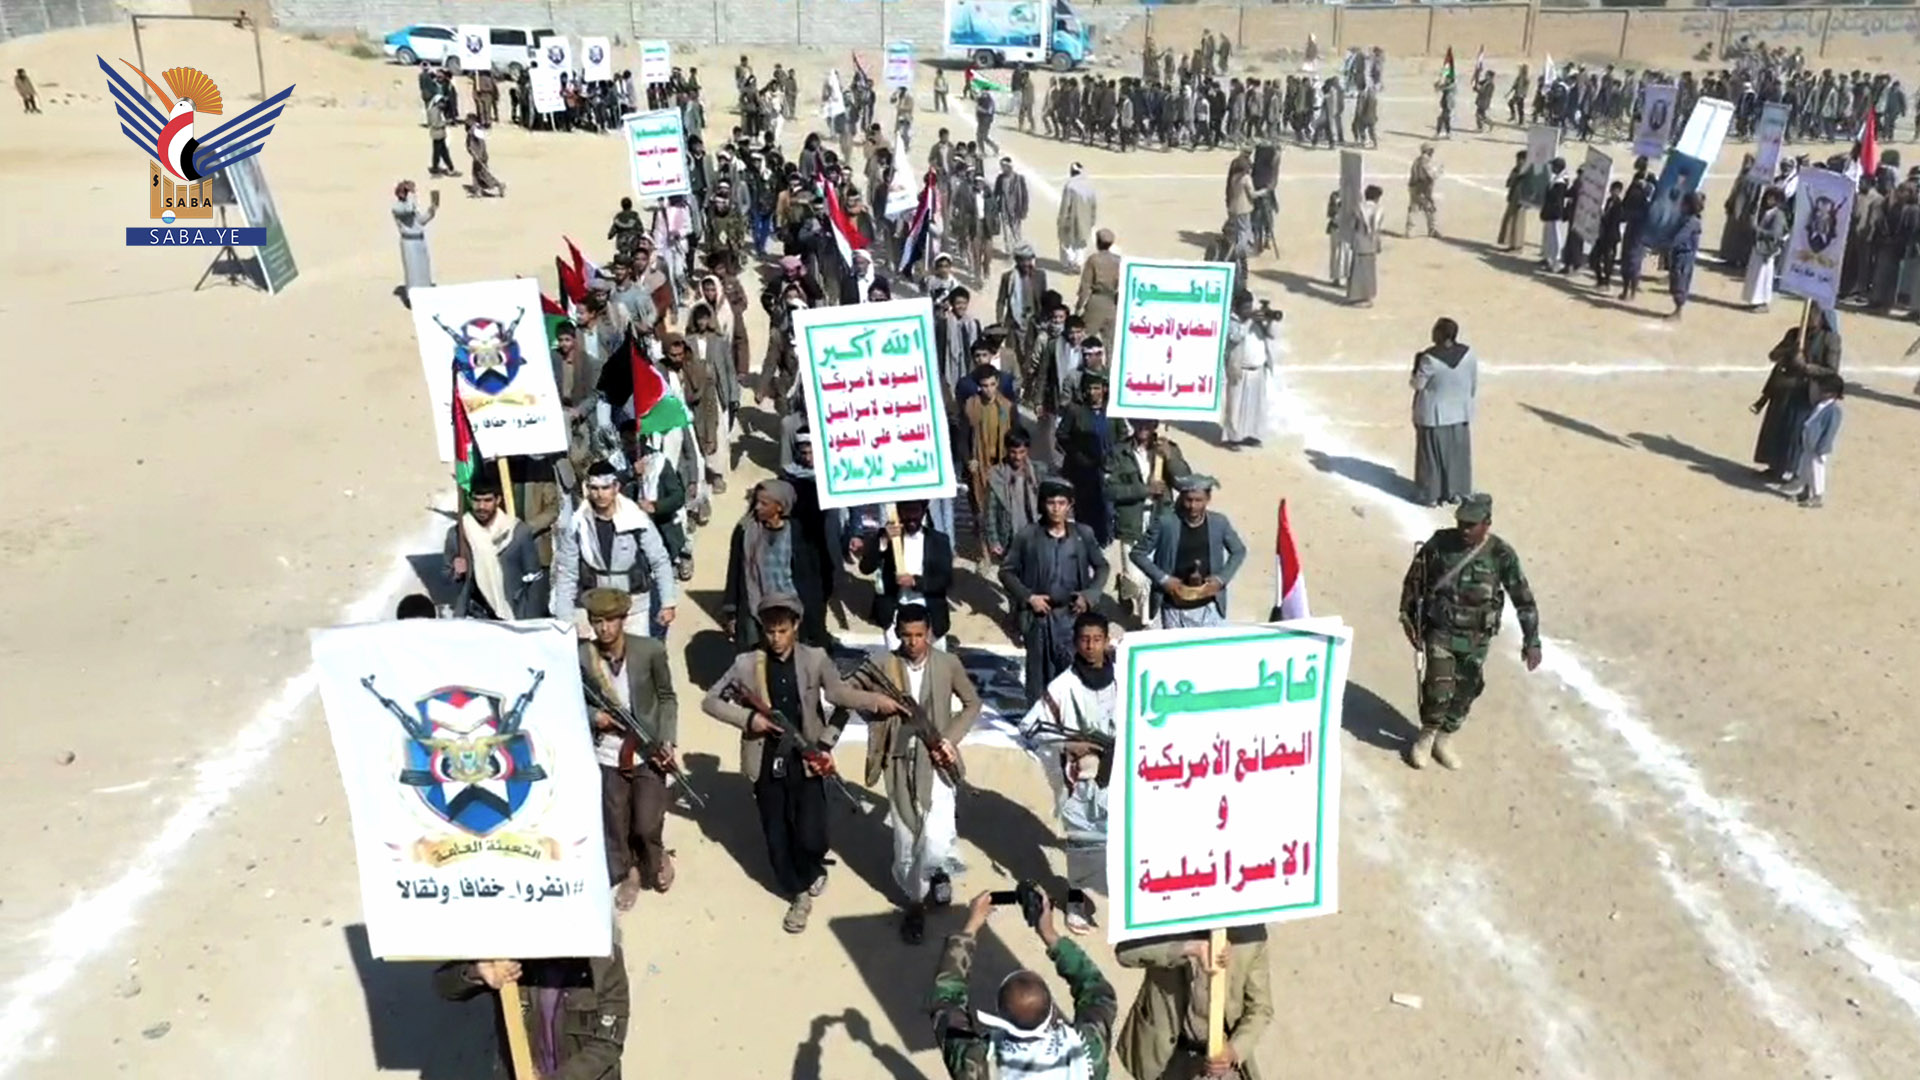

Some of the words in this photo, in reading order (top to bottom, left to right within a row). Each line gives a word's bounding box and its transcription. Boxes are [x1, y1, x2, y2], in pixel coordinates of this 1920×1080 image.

[1131, 276, 1221, 307] قاطعوا
[881, 328, 920, 355] الله
[878, 365, 923, 389] الموت
[882, 395, 927, 418] الموت
[891, 448, 934, 482] النصر
[1139, 653, 1318, 727] قاطعوا
[1137, 731, 1230, 790] الأمريكية
[1235, 730, 1312, 782] البضائع
[1216, 795, 1228, 830] و
[1138, 839, 1310, 901] الإسرائيلية
